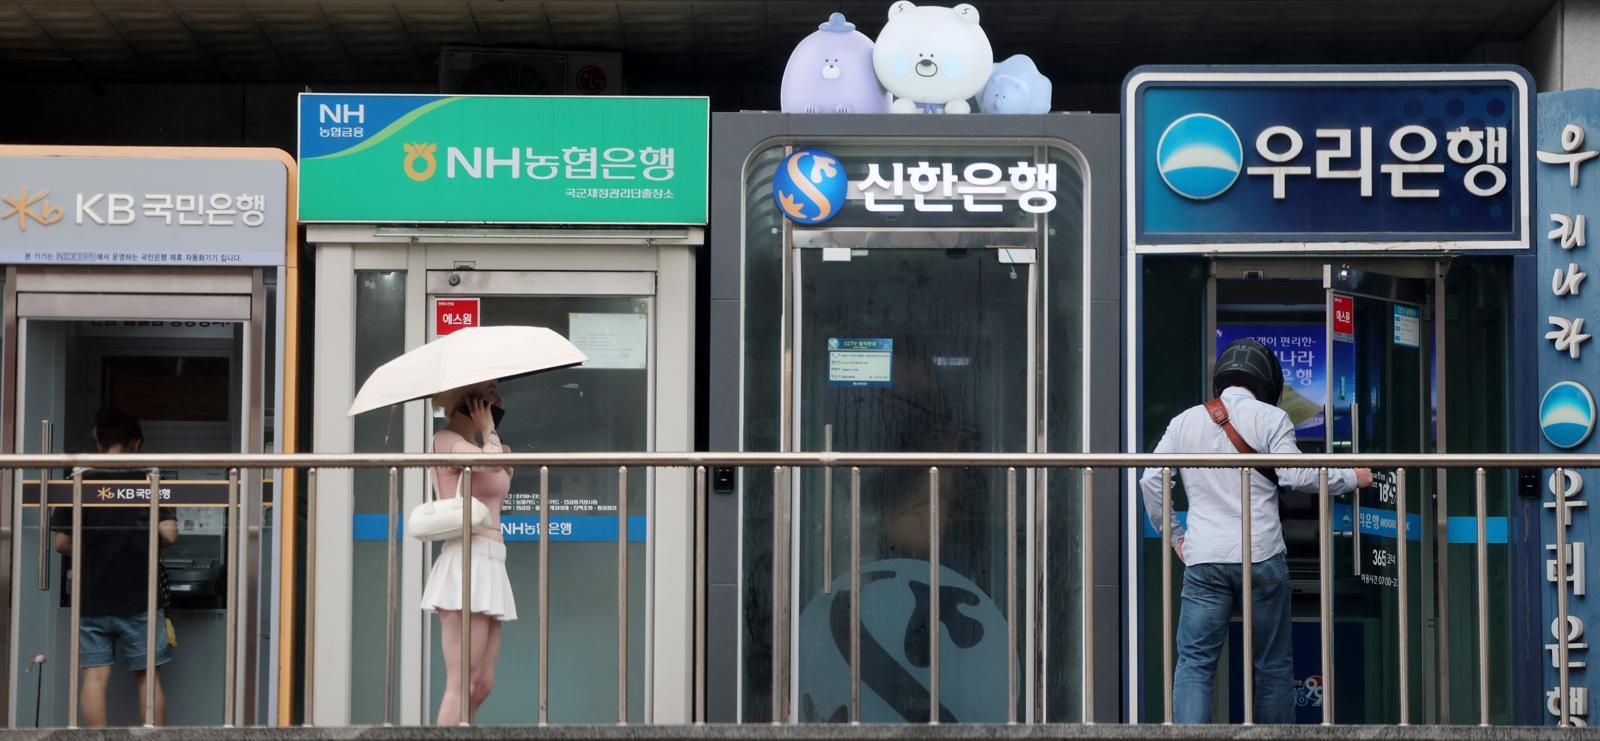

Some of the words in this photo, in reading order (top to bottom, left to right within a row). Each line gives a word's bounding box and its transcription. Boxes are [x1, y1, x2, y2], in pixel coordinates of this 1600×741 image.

[319, 103, 364, 123] NH
[319, 127, 364, 138] 농협금융
[447, 146, 674, 182] NH농협은행
[1246, 125, 1507, 199] 우리은행
[564, 188, 674, 199] 국군재정관리단출장소
[857, 161, 1057, 213] 신한은행
[141, 253, 167, 262] 국민은행
[185, 253, 218, 262] 자동화기기
[442, 312, 472, 325] 에스원
[1336, 310, 1351, 324] 에스원
[1372, 549, 1387, 566] 365
